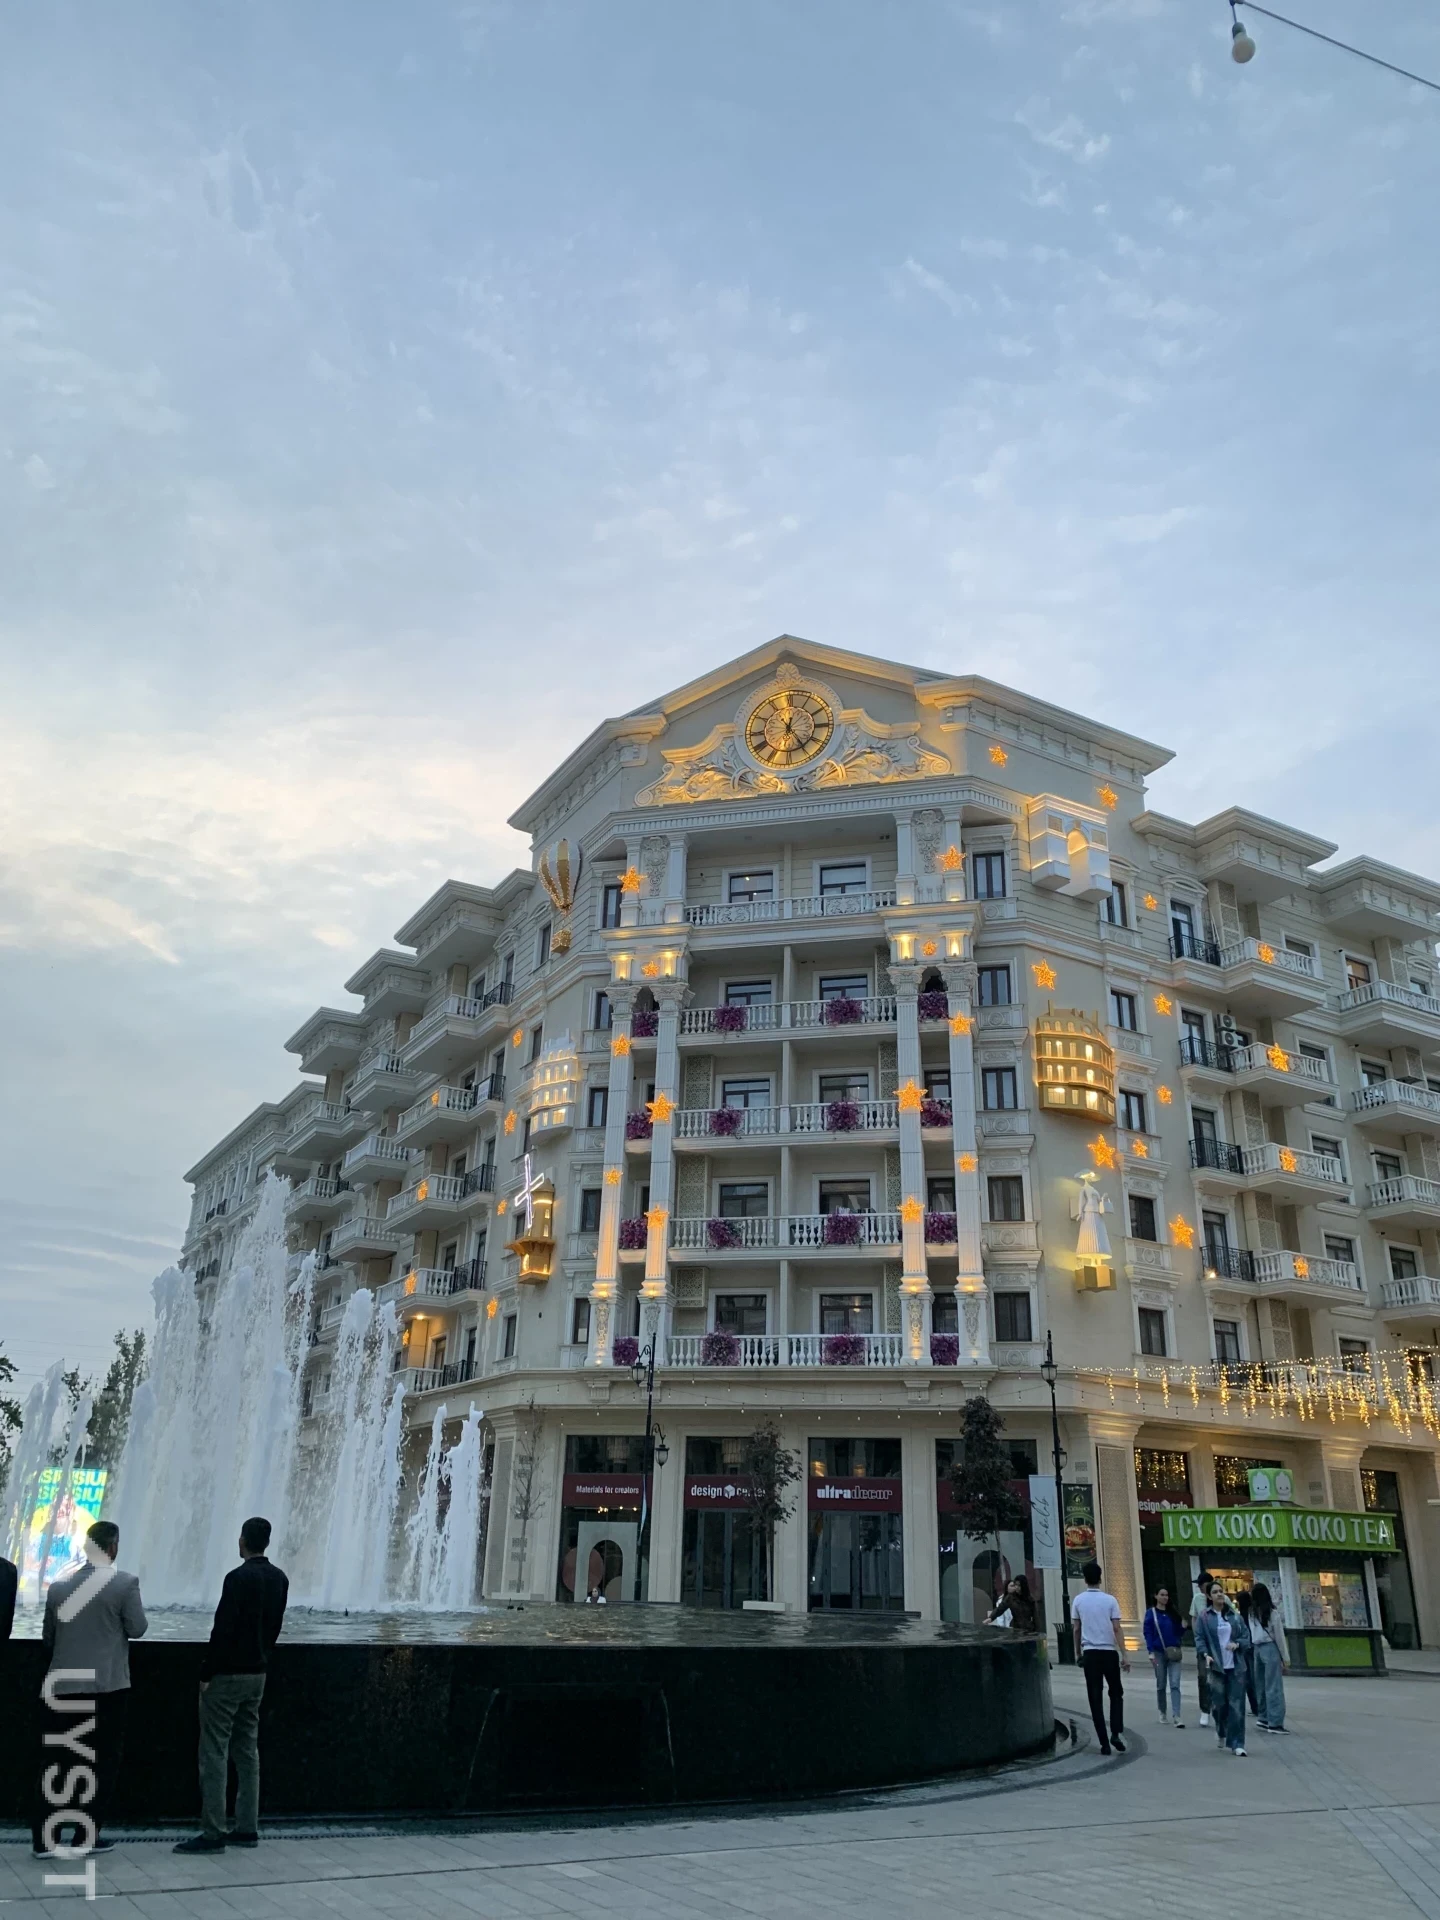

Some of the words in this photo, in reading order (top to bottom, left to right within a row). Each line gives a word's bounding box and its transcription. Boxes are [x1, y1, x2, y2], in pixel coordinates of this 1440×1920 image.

[576, 1485, 604, 1494] Materials
[605, 1486, 614, 1494] for
[615, 1486, 640, 1495] creators
[691, 1484, 723, 1499] design
[736, 1486, 767, 1498] ceer
[816, 1484, 893, 1500] ultradecor
[1138, 1498, 1162, 1515] esign
[1167, 1514, 1205, 1540] ICY
[1213, 1513, 1276, 1540] KOKO
[1291, 1514, 1346, 1542] KOKO
[1351, 1517, 1390, 1545] TEA
